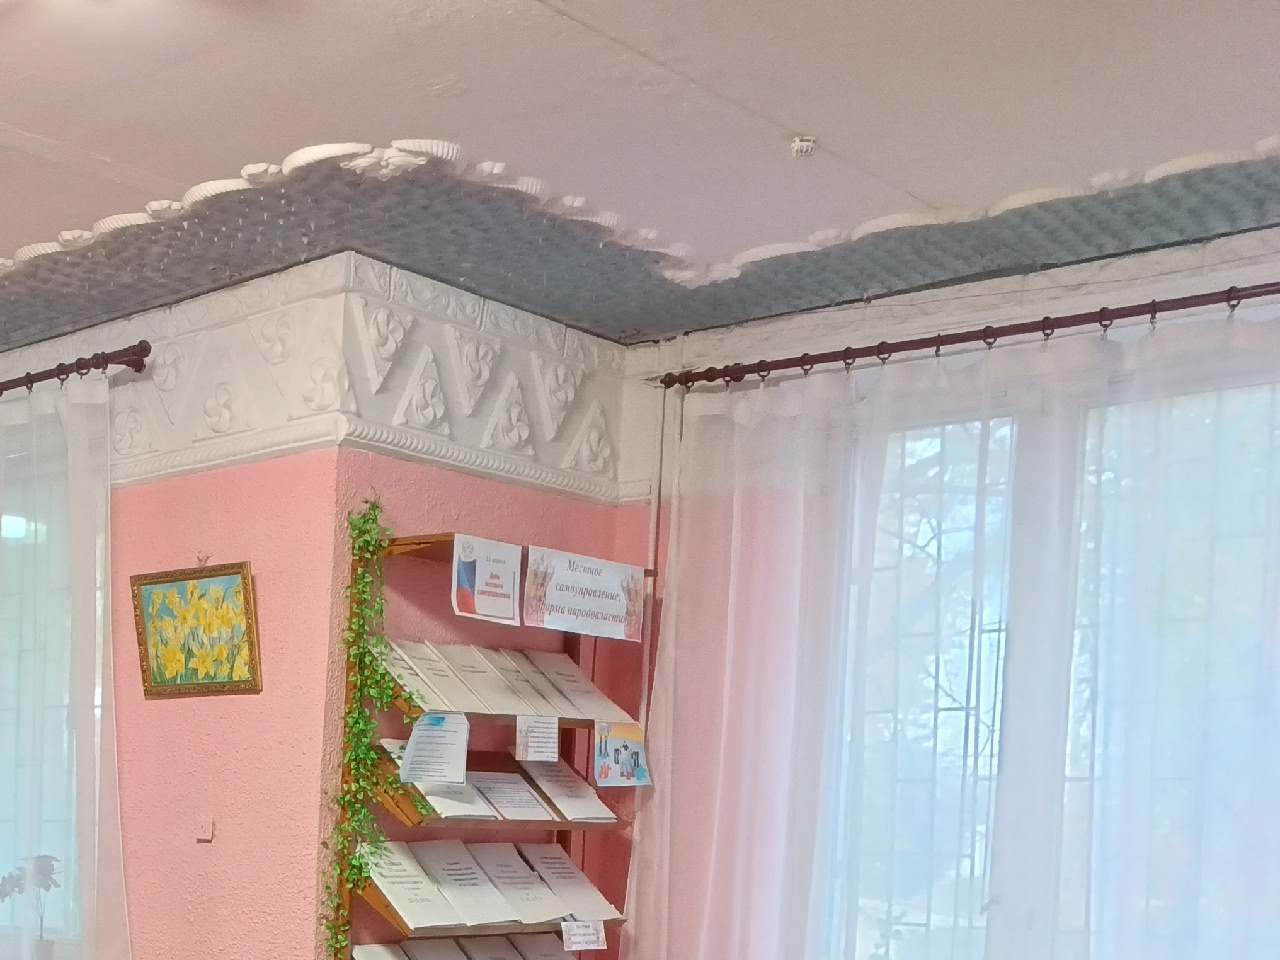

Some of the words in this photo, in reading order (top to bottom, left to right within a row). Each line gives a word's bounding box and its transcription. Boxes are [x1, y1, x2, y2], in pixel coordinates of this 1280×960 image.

[566, 559, 604, 577] Местное
[538, 599, 566, 615] форма
[567, 607, 628, 624] народовластия
